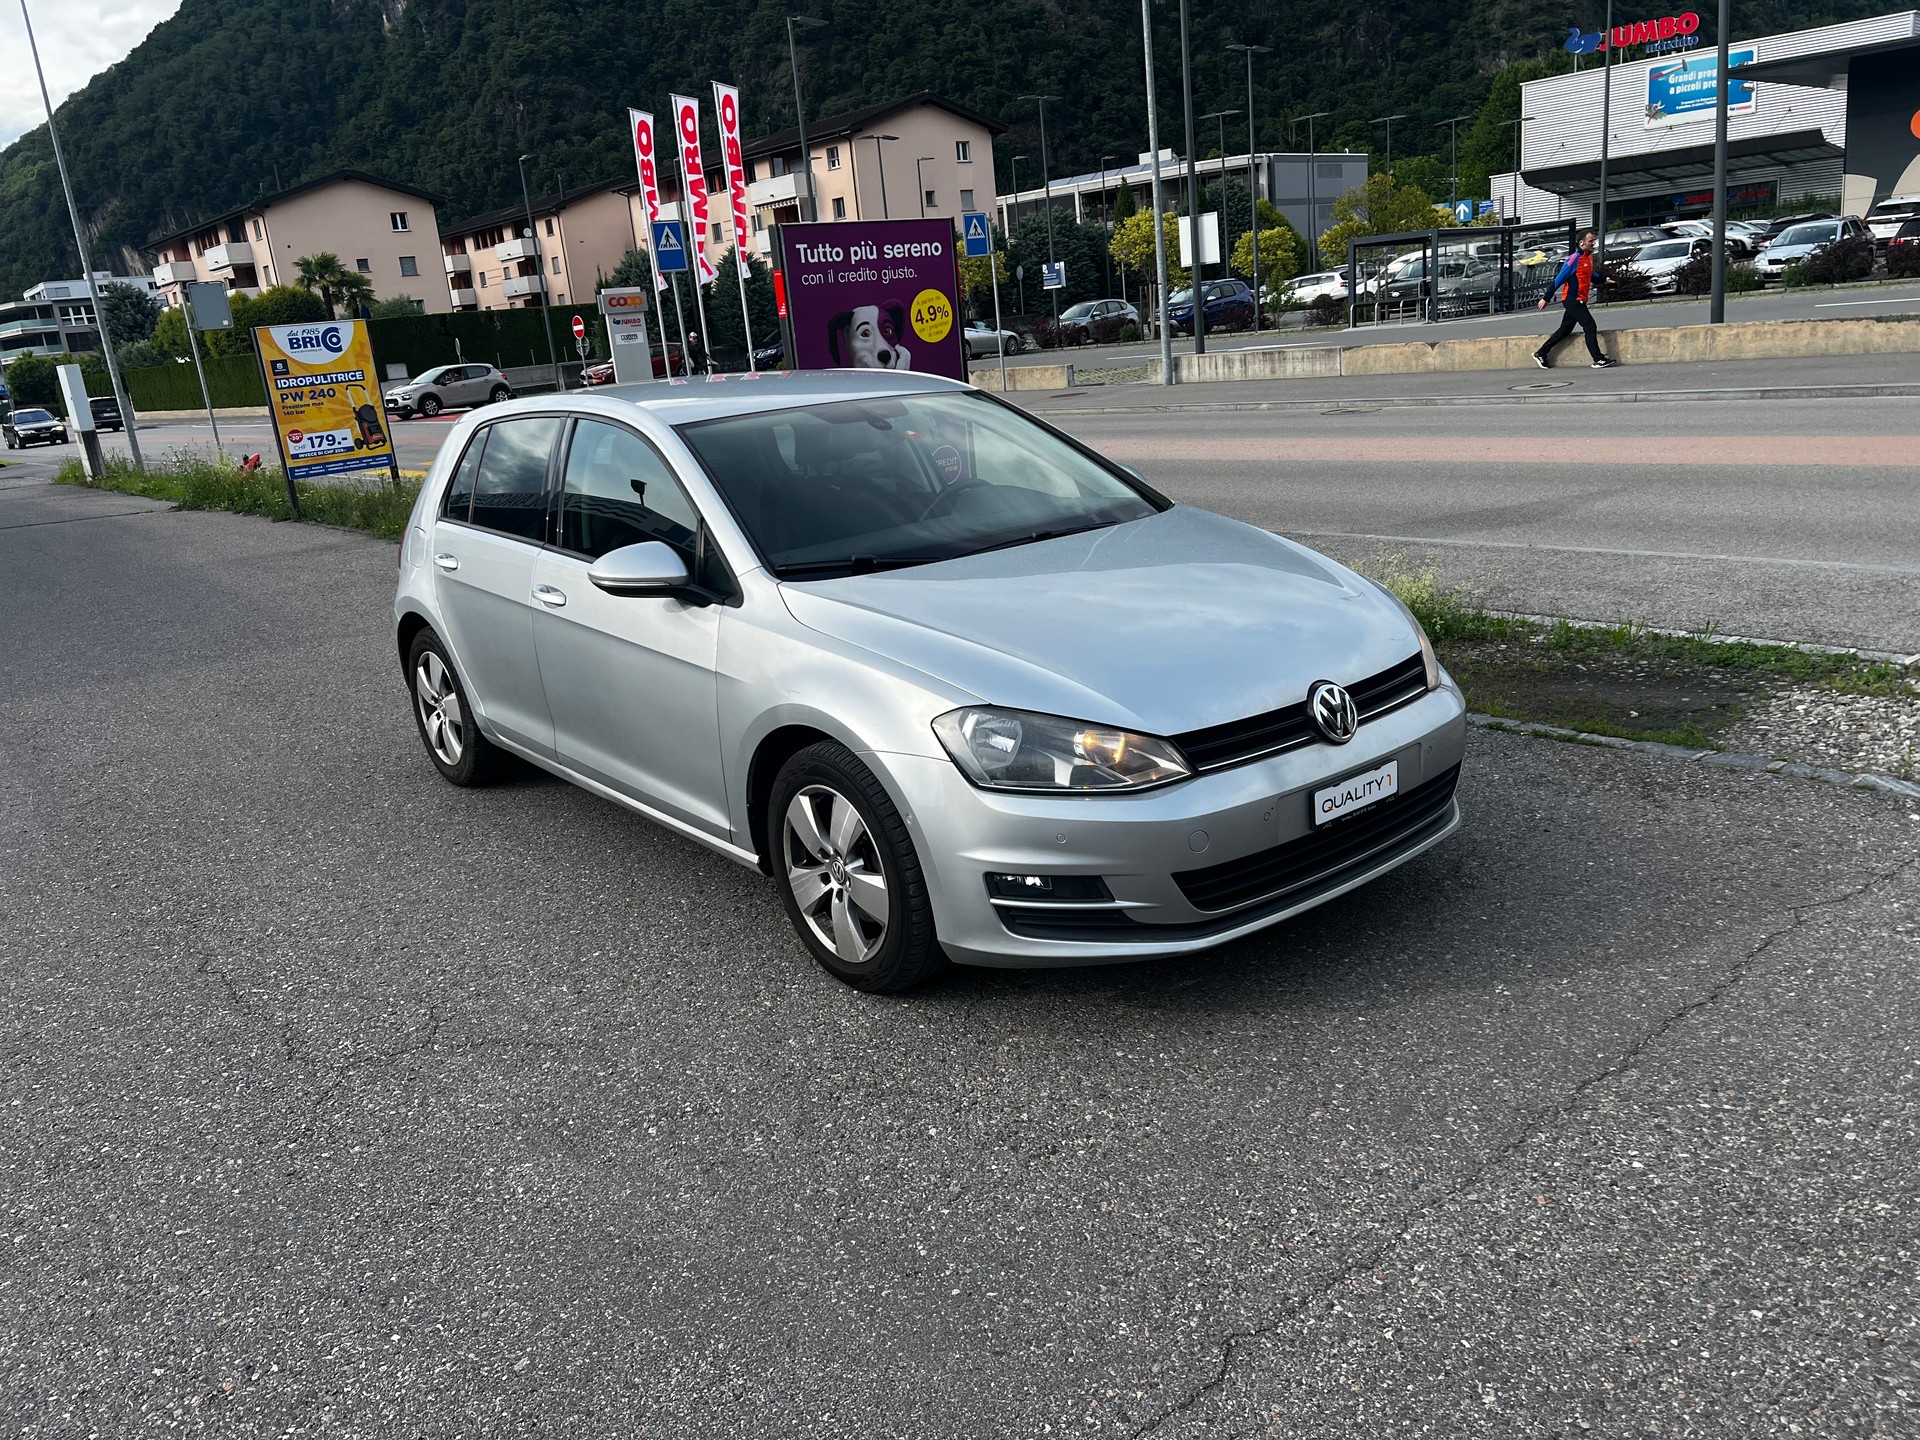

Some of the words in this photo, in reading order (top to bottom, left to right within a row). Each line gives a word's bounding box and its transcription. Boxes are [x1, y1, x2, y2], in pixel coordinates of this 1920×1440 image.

[1600, 12, 1699, 51] JUMBO
[1669, 70, 1697, 84] Grandi
[1676, 82, 1701, 94] piccoli
[795, 243, 844, 264] Tutto
[850, 241, 877, 264] più
[883, 242, 942, 259] sereno
[801, 273, 824, 285] con
[828, 269, 834, 283] il
[838, 267, 878, 283] credito
[881, 266, 918, 284] giusto.
[608, 294, 644, 309] coop
[915, 304, 949, 325] 4.9%
[301, 327, 320, 336] 1985
[277, 371, 364, 388] IDROPULITRICE
[280, 391, 304, 403] PW
[309, 387, 336, 400] 240
[282, 402, 310, 410] Pressione
[936, 457, 957, 467] REDIT
[1322, 776, 1384, 813] QUALITY
[1386, 774, 1392, 786] 1
